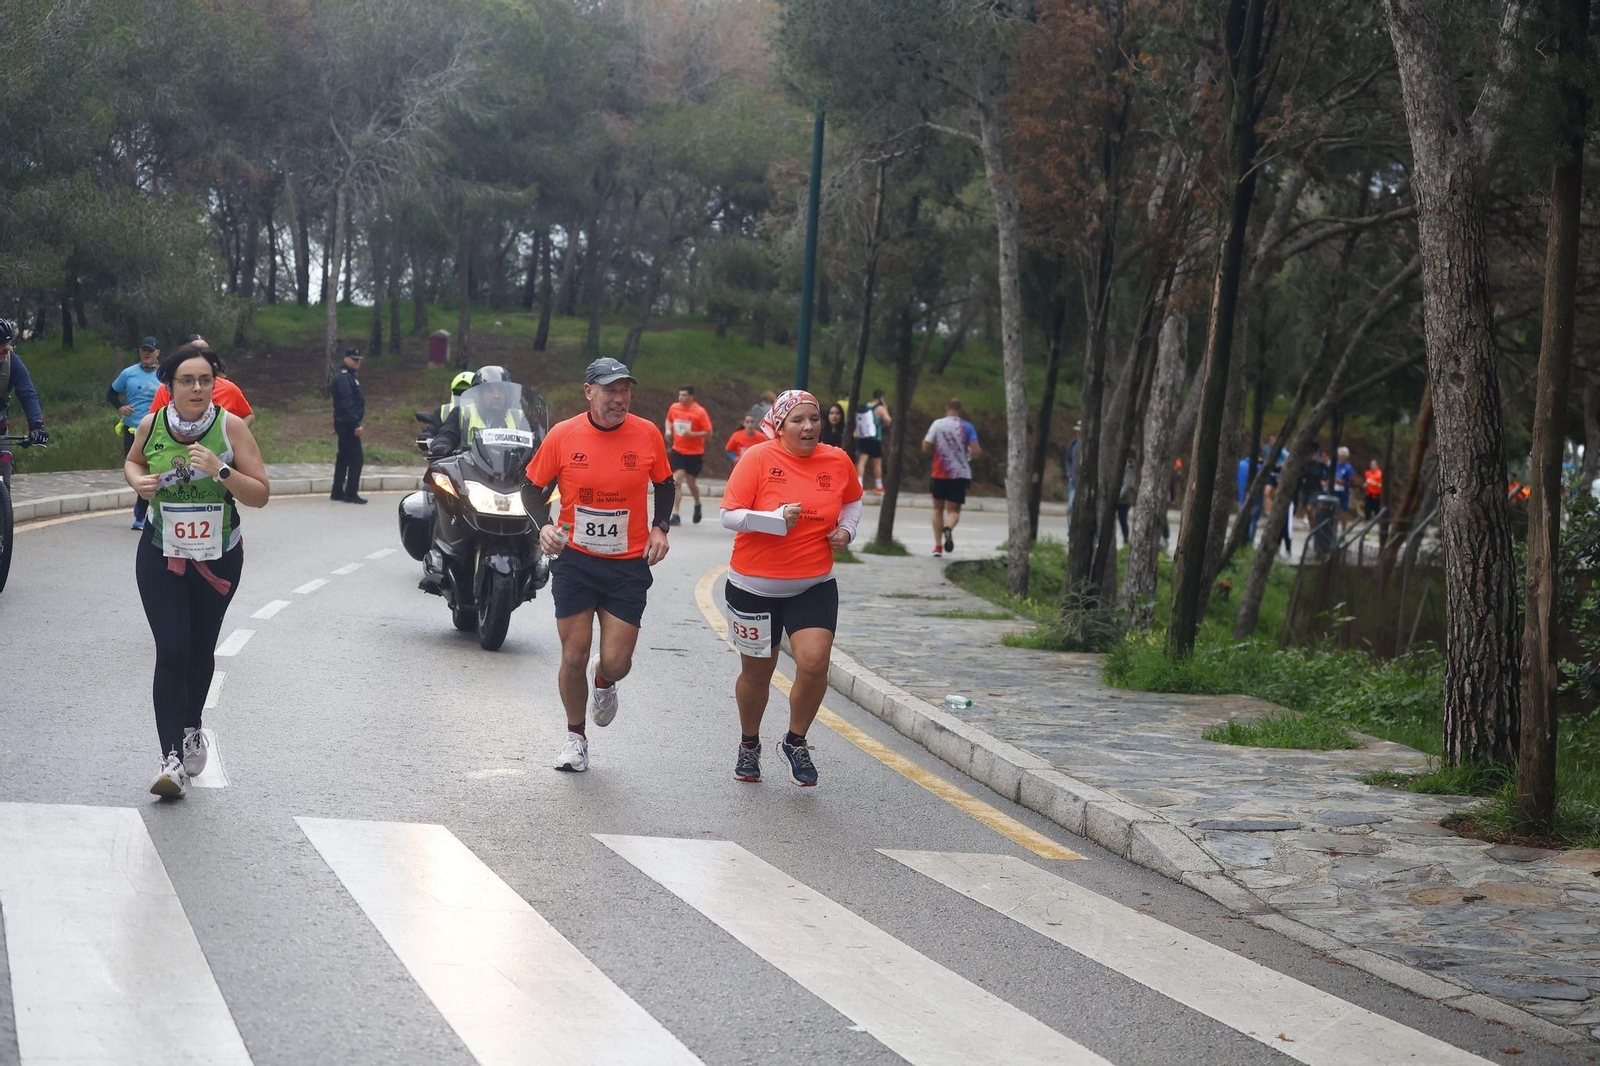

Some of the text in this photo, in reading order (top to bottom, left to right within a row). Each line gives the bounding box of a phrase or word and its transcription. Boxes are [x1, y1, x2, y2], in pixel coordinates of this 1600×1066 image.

[174, 520, 211, 539] 612
[585, 522, 619, 538] 814
[733, 621, 759, 640] 633
